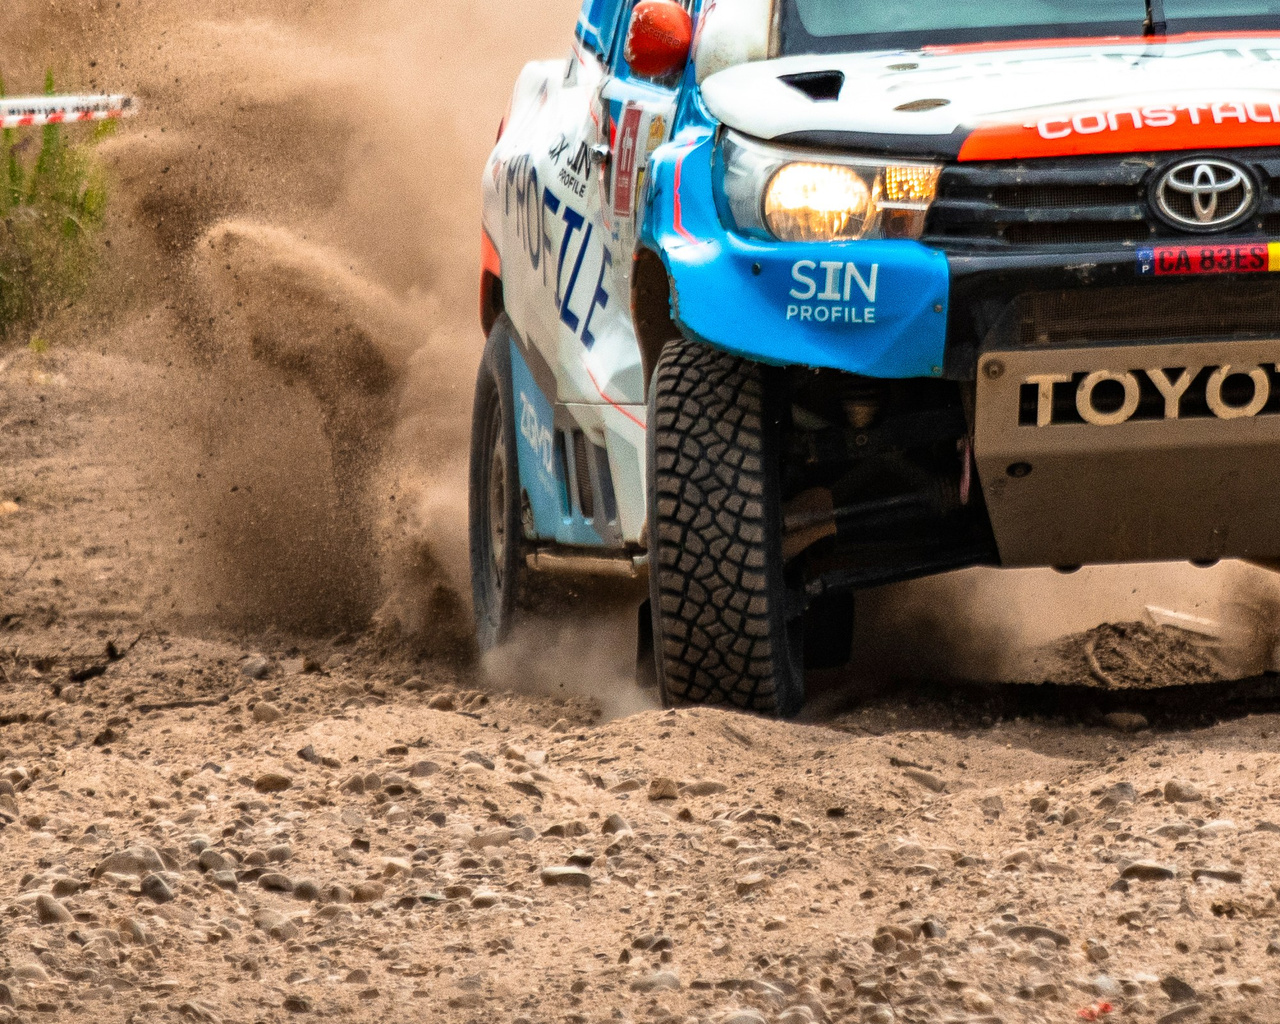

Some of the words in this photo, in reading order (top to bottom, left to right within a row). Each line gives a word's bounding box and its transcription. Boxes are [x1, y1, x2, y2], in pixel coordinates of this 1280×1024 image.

[1159, 249, 1191, 272] CA
[789, 260, 879, 303] SIN
[786, 305, 876, 323] PROFILE
